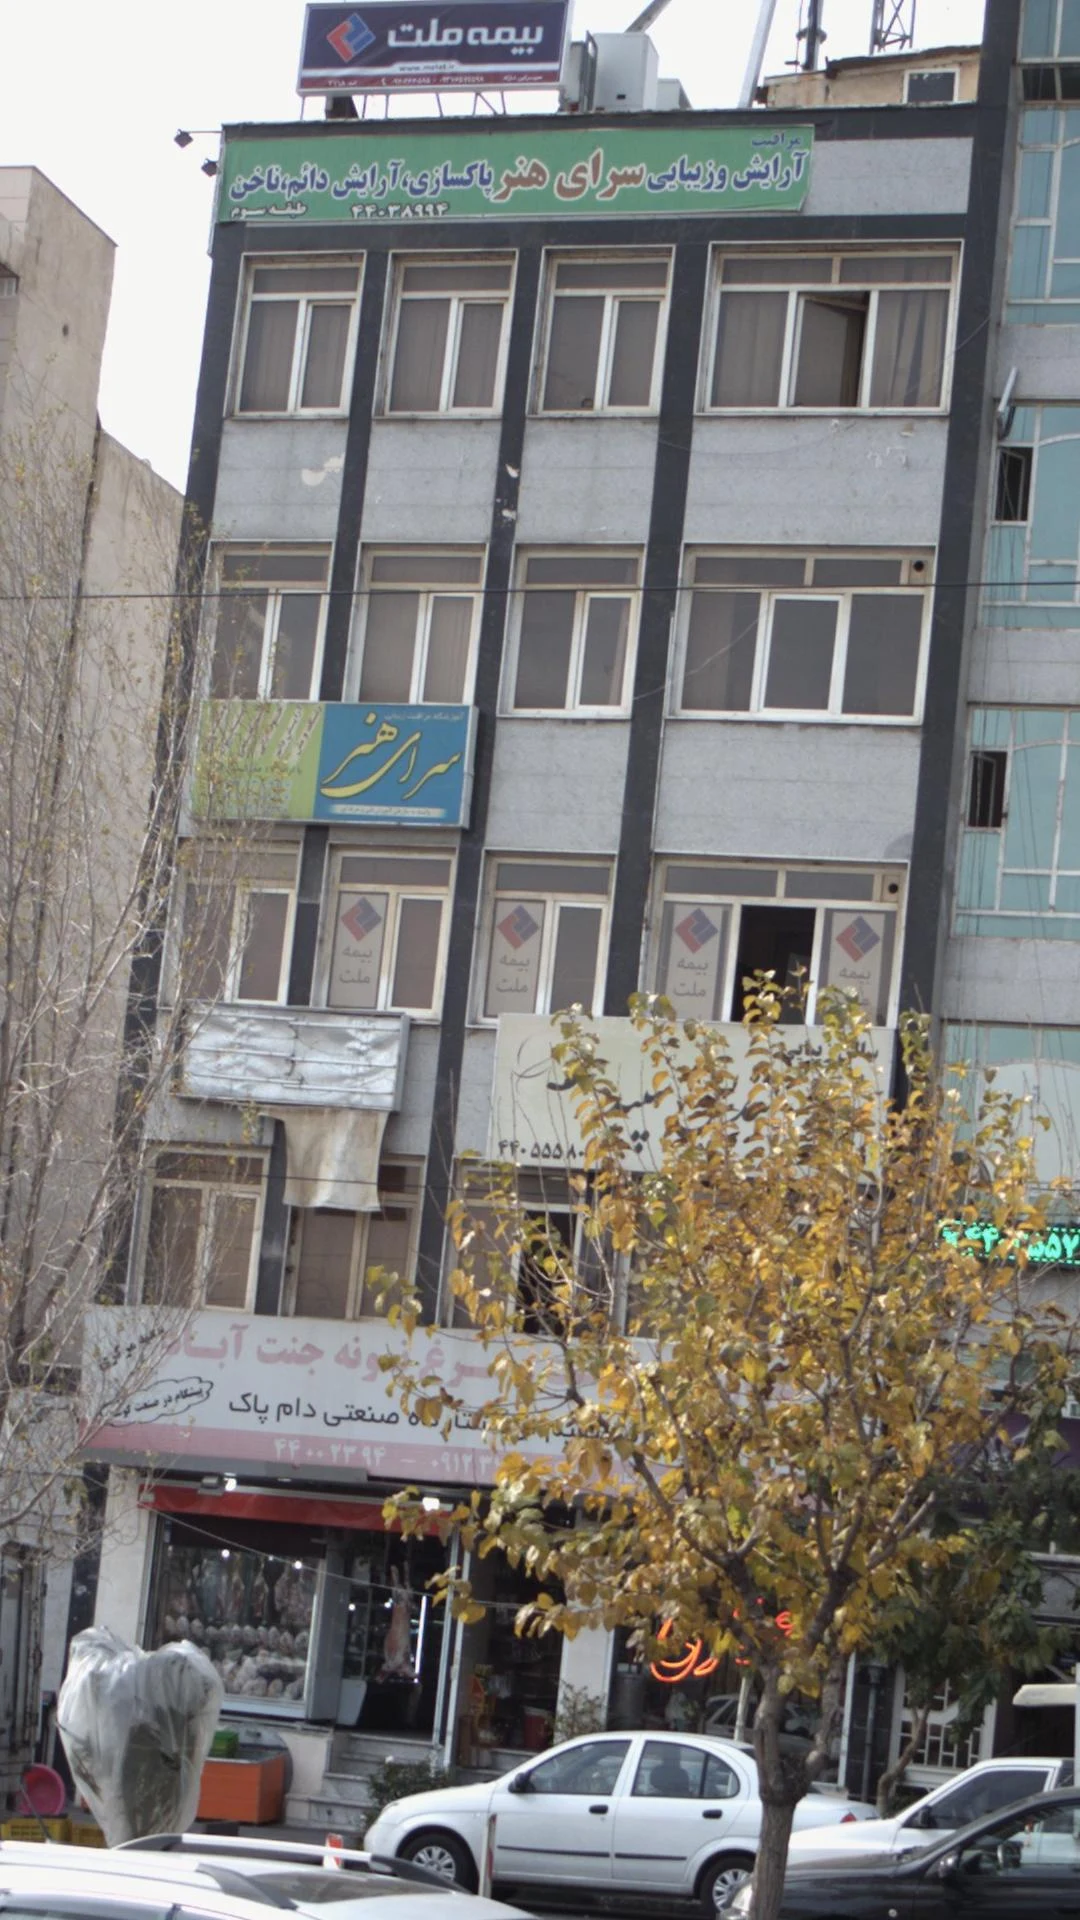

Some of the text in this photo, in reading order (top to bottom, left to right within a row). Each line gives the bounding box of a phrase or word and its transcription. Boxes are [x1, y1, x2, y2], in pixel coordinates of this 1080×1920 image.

[387, 18, 544, 55] بیمه ملت
[332, 160, 402, 199] آرایش
[490, 155, 549, 203] هنر
[554, 145, 647, 201] سرای
[733, 150, 811, 192] آرایش
[230, 205, 266, 219] سوم
[268, 201, 307, 219] طبقه
[342, 946, 373, 963] بیمه
[499, 953, 530, 972] بیمه
[339, 968, 370, 985] ملت
[677, 957, 709, 976] بیمه
[839, 966, 871, 985] بیمه
[495, 976, 528, 993] ملت
[673, 980, 706, 998] ملت
[255, 1335, 325, 1376] جنت
[228, 1392, 269, 1424] پاک
[276, 1397, 316, 1423] دام
[323, 1403, 399, 1426] صنعتی
